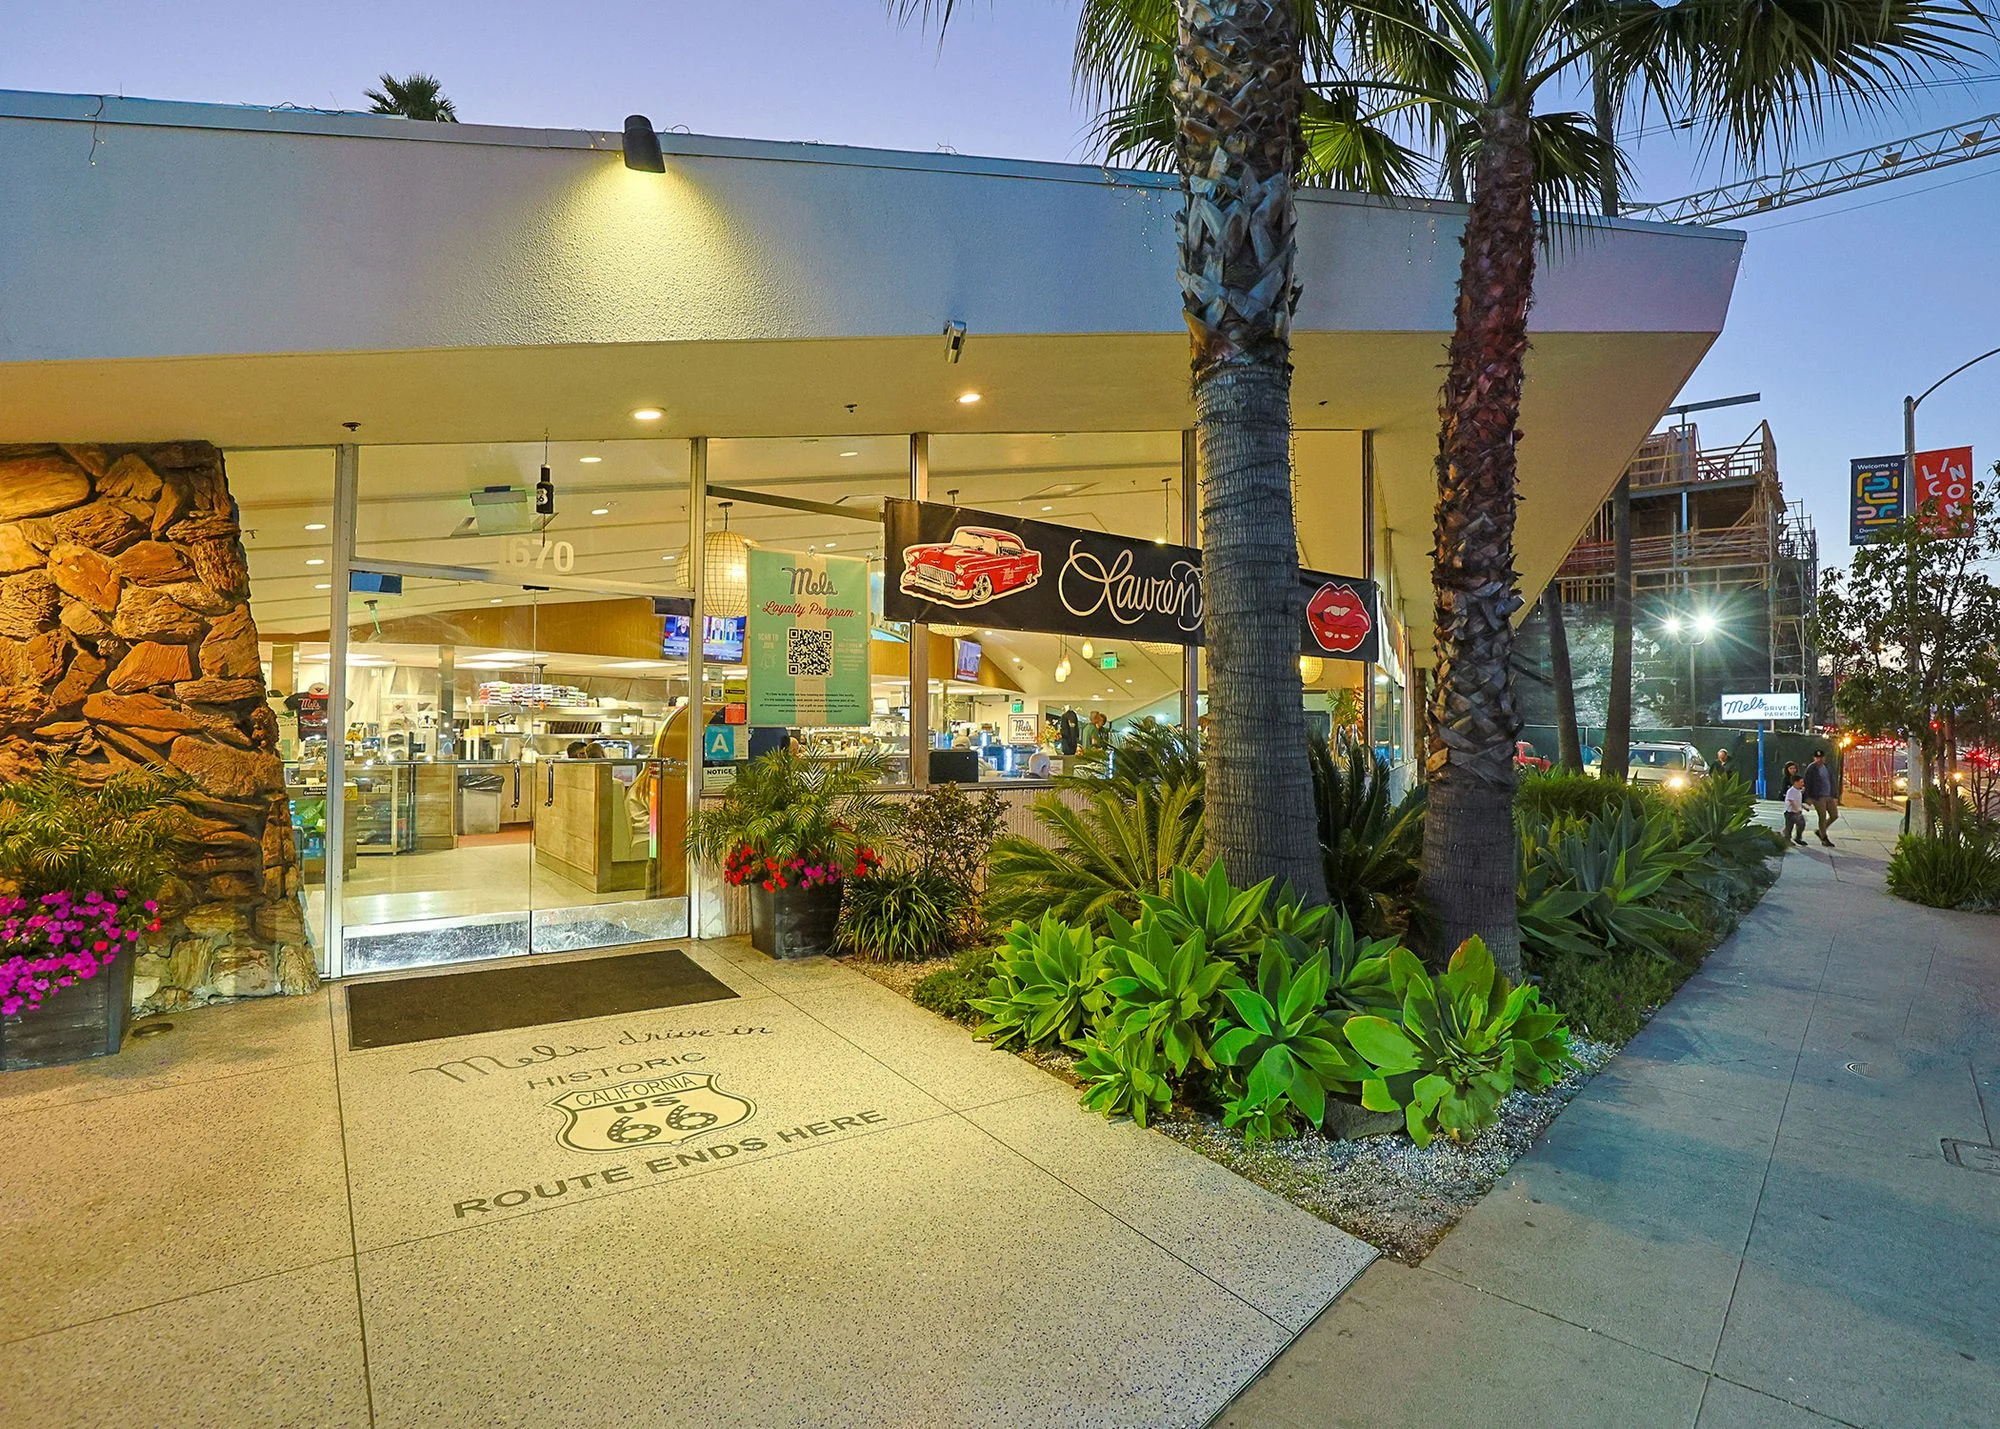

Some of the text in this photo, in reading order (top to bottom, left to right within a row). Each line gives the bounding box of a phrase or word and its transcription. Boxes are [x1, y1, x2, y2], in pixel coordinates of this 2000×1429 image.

[1857, 462, 1889, 471] Welcome
[781, 567, 838, 595] Mels
[763, 600, 855, 619] Loyalty Program
[1724, 696, 1767, 715] Mels
[711, 733, 730, 753] A
[706, 768, 732, 776] NOTICE
[410, 1044, 606, 1083] Mels
[527, 1052, 707, 1090] HISTORIC
[575, 1075, 698, 1107] CALIFORNIA
[612, 1096, 680, 1114] US
[606, 1104, 718, 1146] 66
[453, 1110, 889, 1219] ROUTE ENDS HERE
